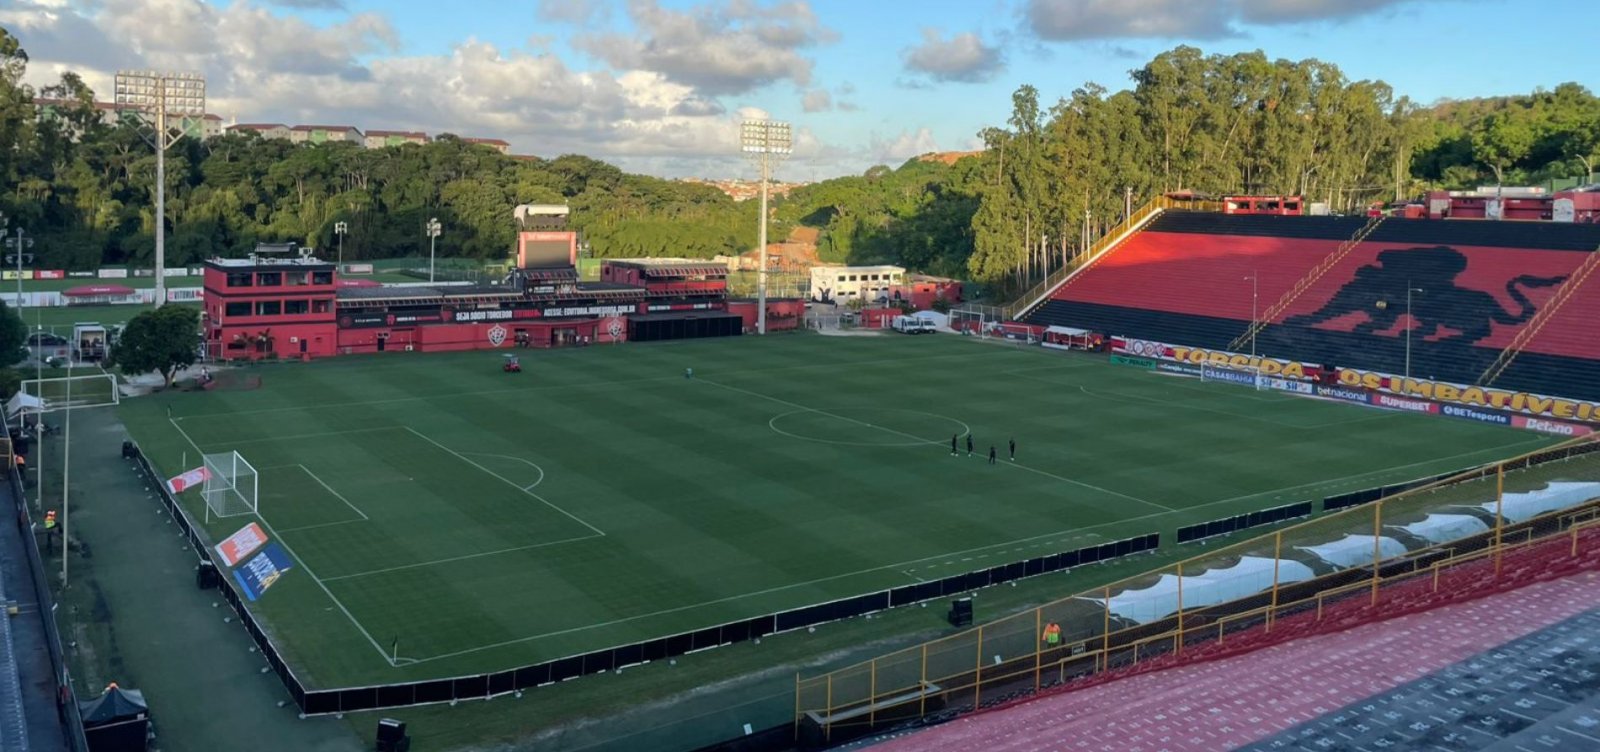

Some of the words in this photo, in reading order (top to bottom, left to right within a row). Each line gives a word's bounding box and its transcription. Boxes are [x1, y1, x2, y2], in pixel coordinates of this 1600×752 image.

[1172, 345, 1304, 378] TORCIDA
[1339, 368, 1381, 389] OS
[1317, 386, 1367, 402] betnacional
[1380, 395, 1431, 411] SUPERBET
[1453, 407, 1507, 424] BETesporte
[1525, 418, 1574, 436] Betano
